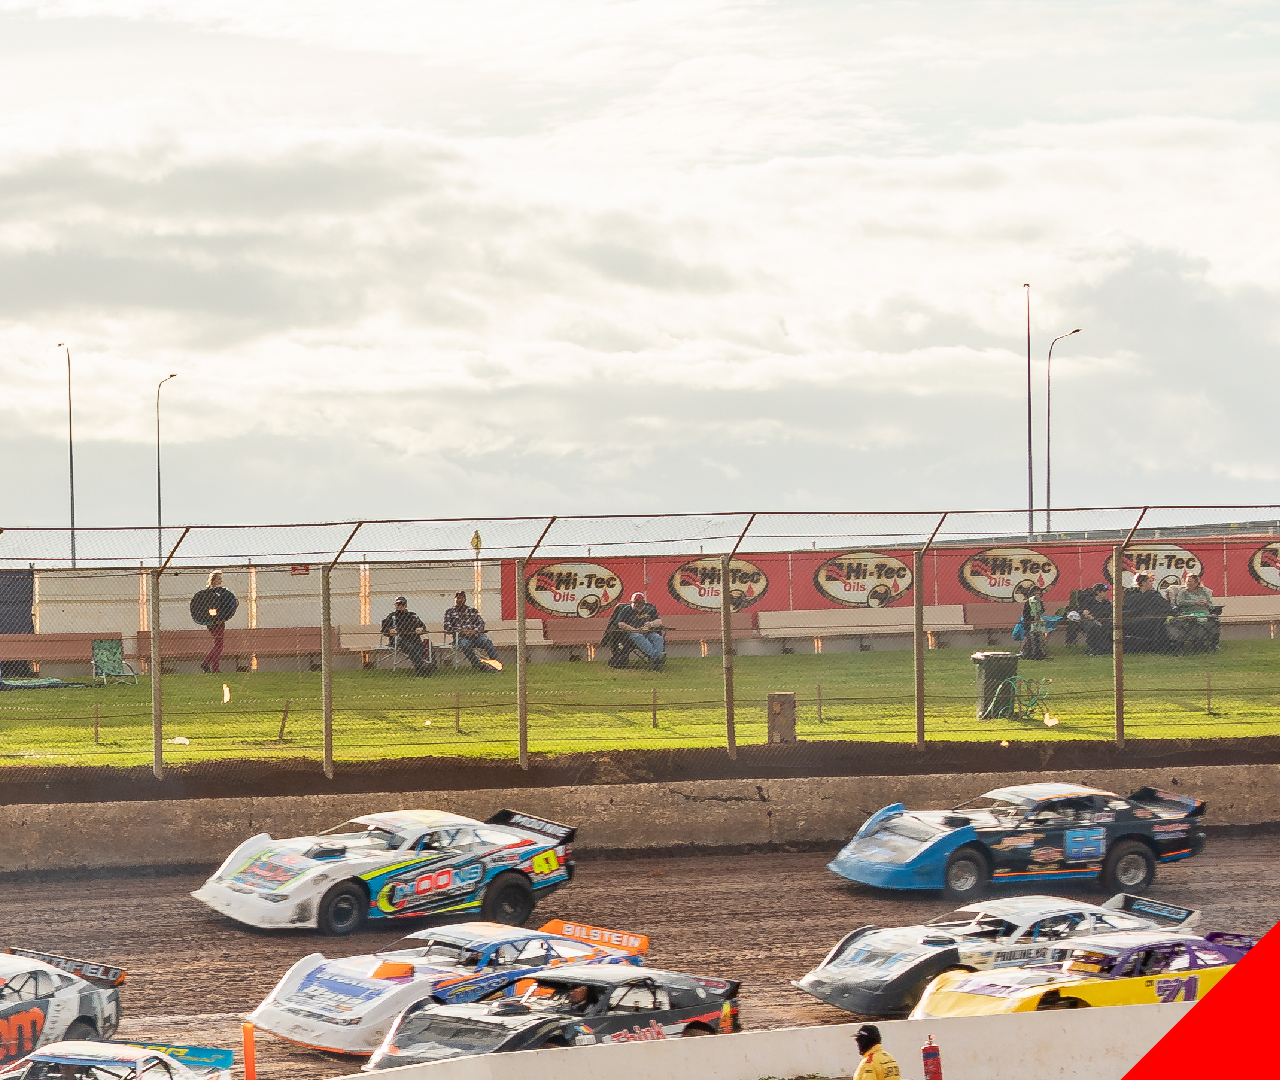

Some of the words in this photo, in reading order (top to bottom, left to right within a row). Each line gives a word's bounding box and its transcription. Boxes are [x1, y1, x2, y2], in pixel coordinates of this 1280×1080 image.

[991, 557, 1052, 575] Hi-Tec
[1134, 552, 1196, 570] Hi-Tec
[700, 567, 761, 585] HiTec
[846, 562, 907, 580] Hi-Tec
[555, 572, 617, 590] Hi-Tec
[844, 581, 867, 593] Oils
[989, 576, 1011, 588] Oils
[553, 591, 576, 603] Oils
[698, 586, 721, 598] Oils
[562, 923, 641, 948] BILSTEIN
